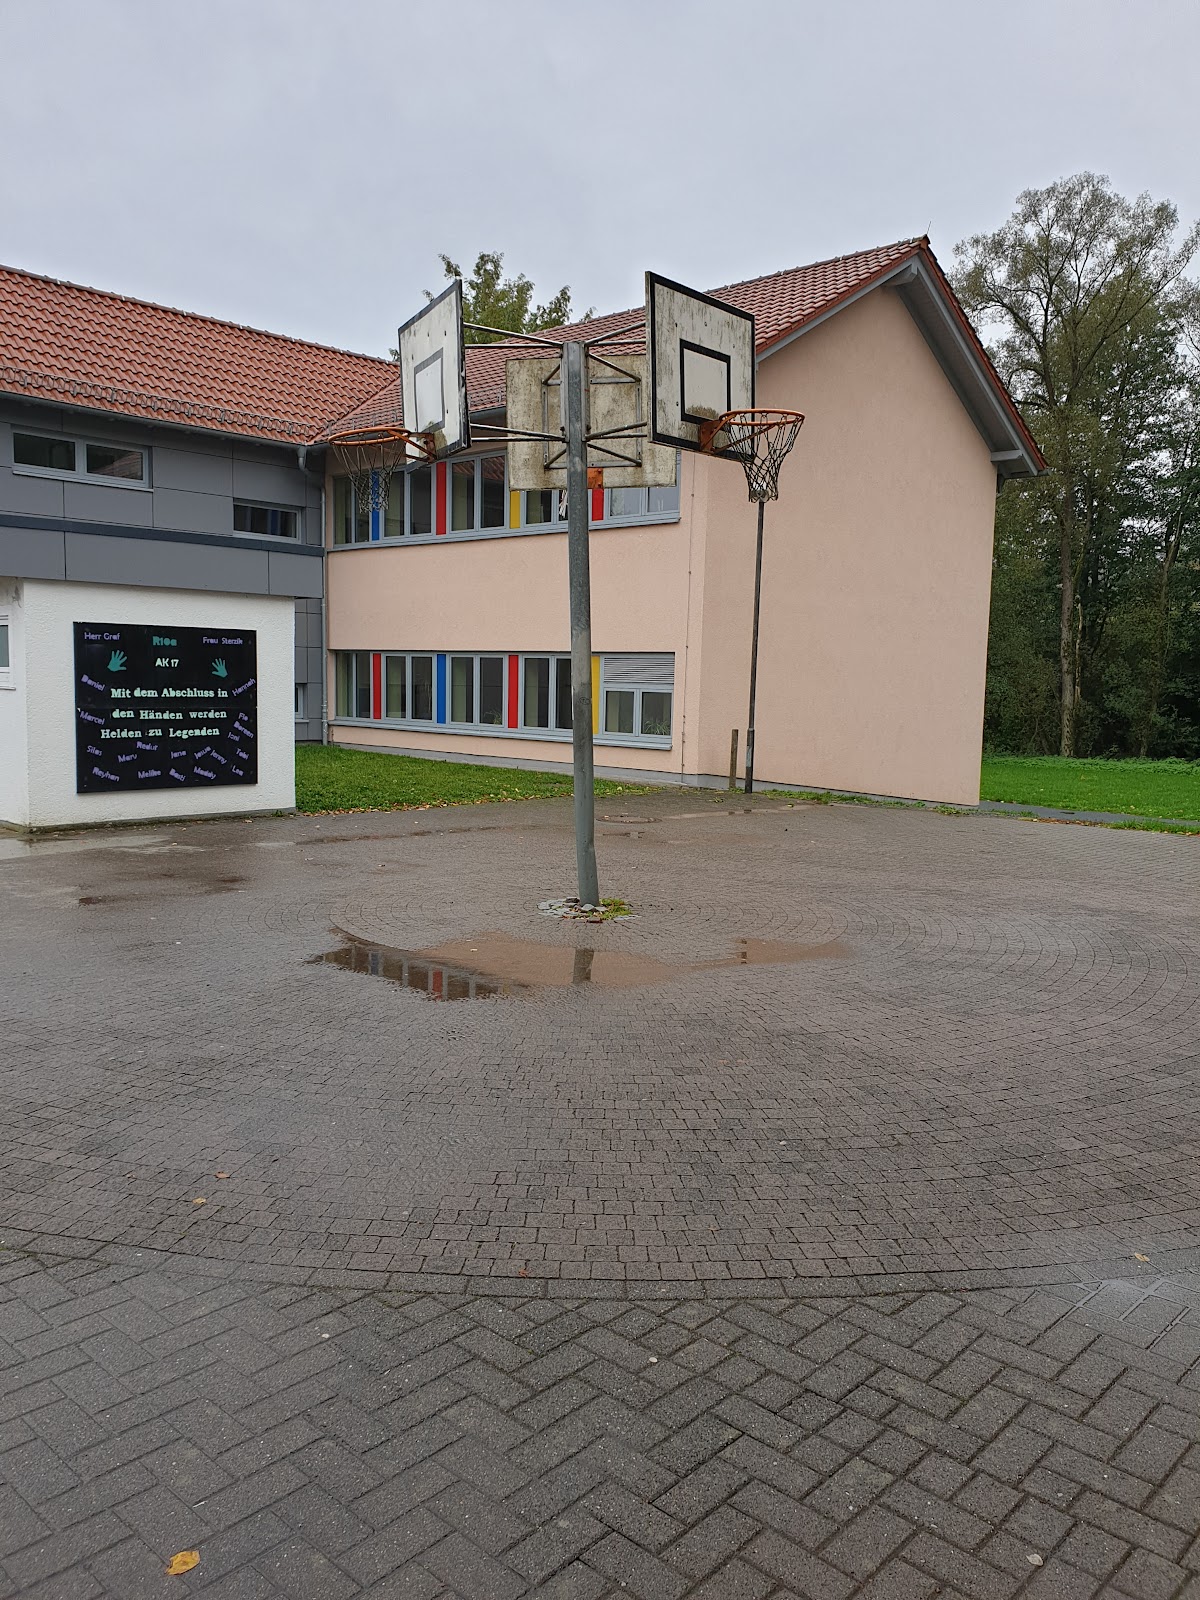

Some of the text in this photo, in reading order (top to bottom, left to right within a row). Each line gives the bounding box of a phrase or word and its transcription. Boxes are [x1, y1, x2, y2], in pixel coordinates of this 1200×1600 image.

[84, 632, 120, 640] Herr Graf
[153, 636, 177, 646] R10a
[155, 658, 179, 667] AK 17
[81, 674, 105, 691] Daniel
[232, 678, 256, 696] Hannah
[111, 688, 228, 698] Mit dem Abschluss in
[79, 711, 105, 725] Marcel
[112, 709, 227, 720] den Händen werden
[101, 729, 142, 739] Helden
[169, 727, 220, 738] Legenden
[86, 746, 102, 757] Silas
[92, 767, 120, 782] Reyhan
